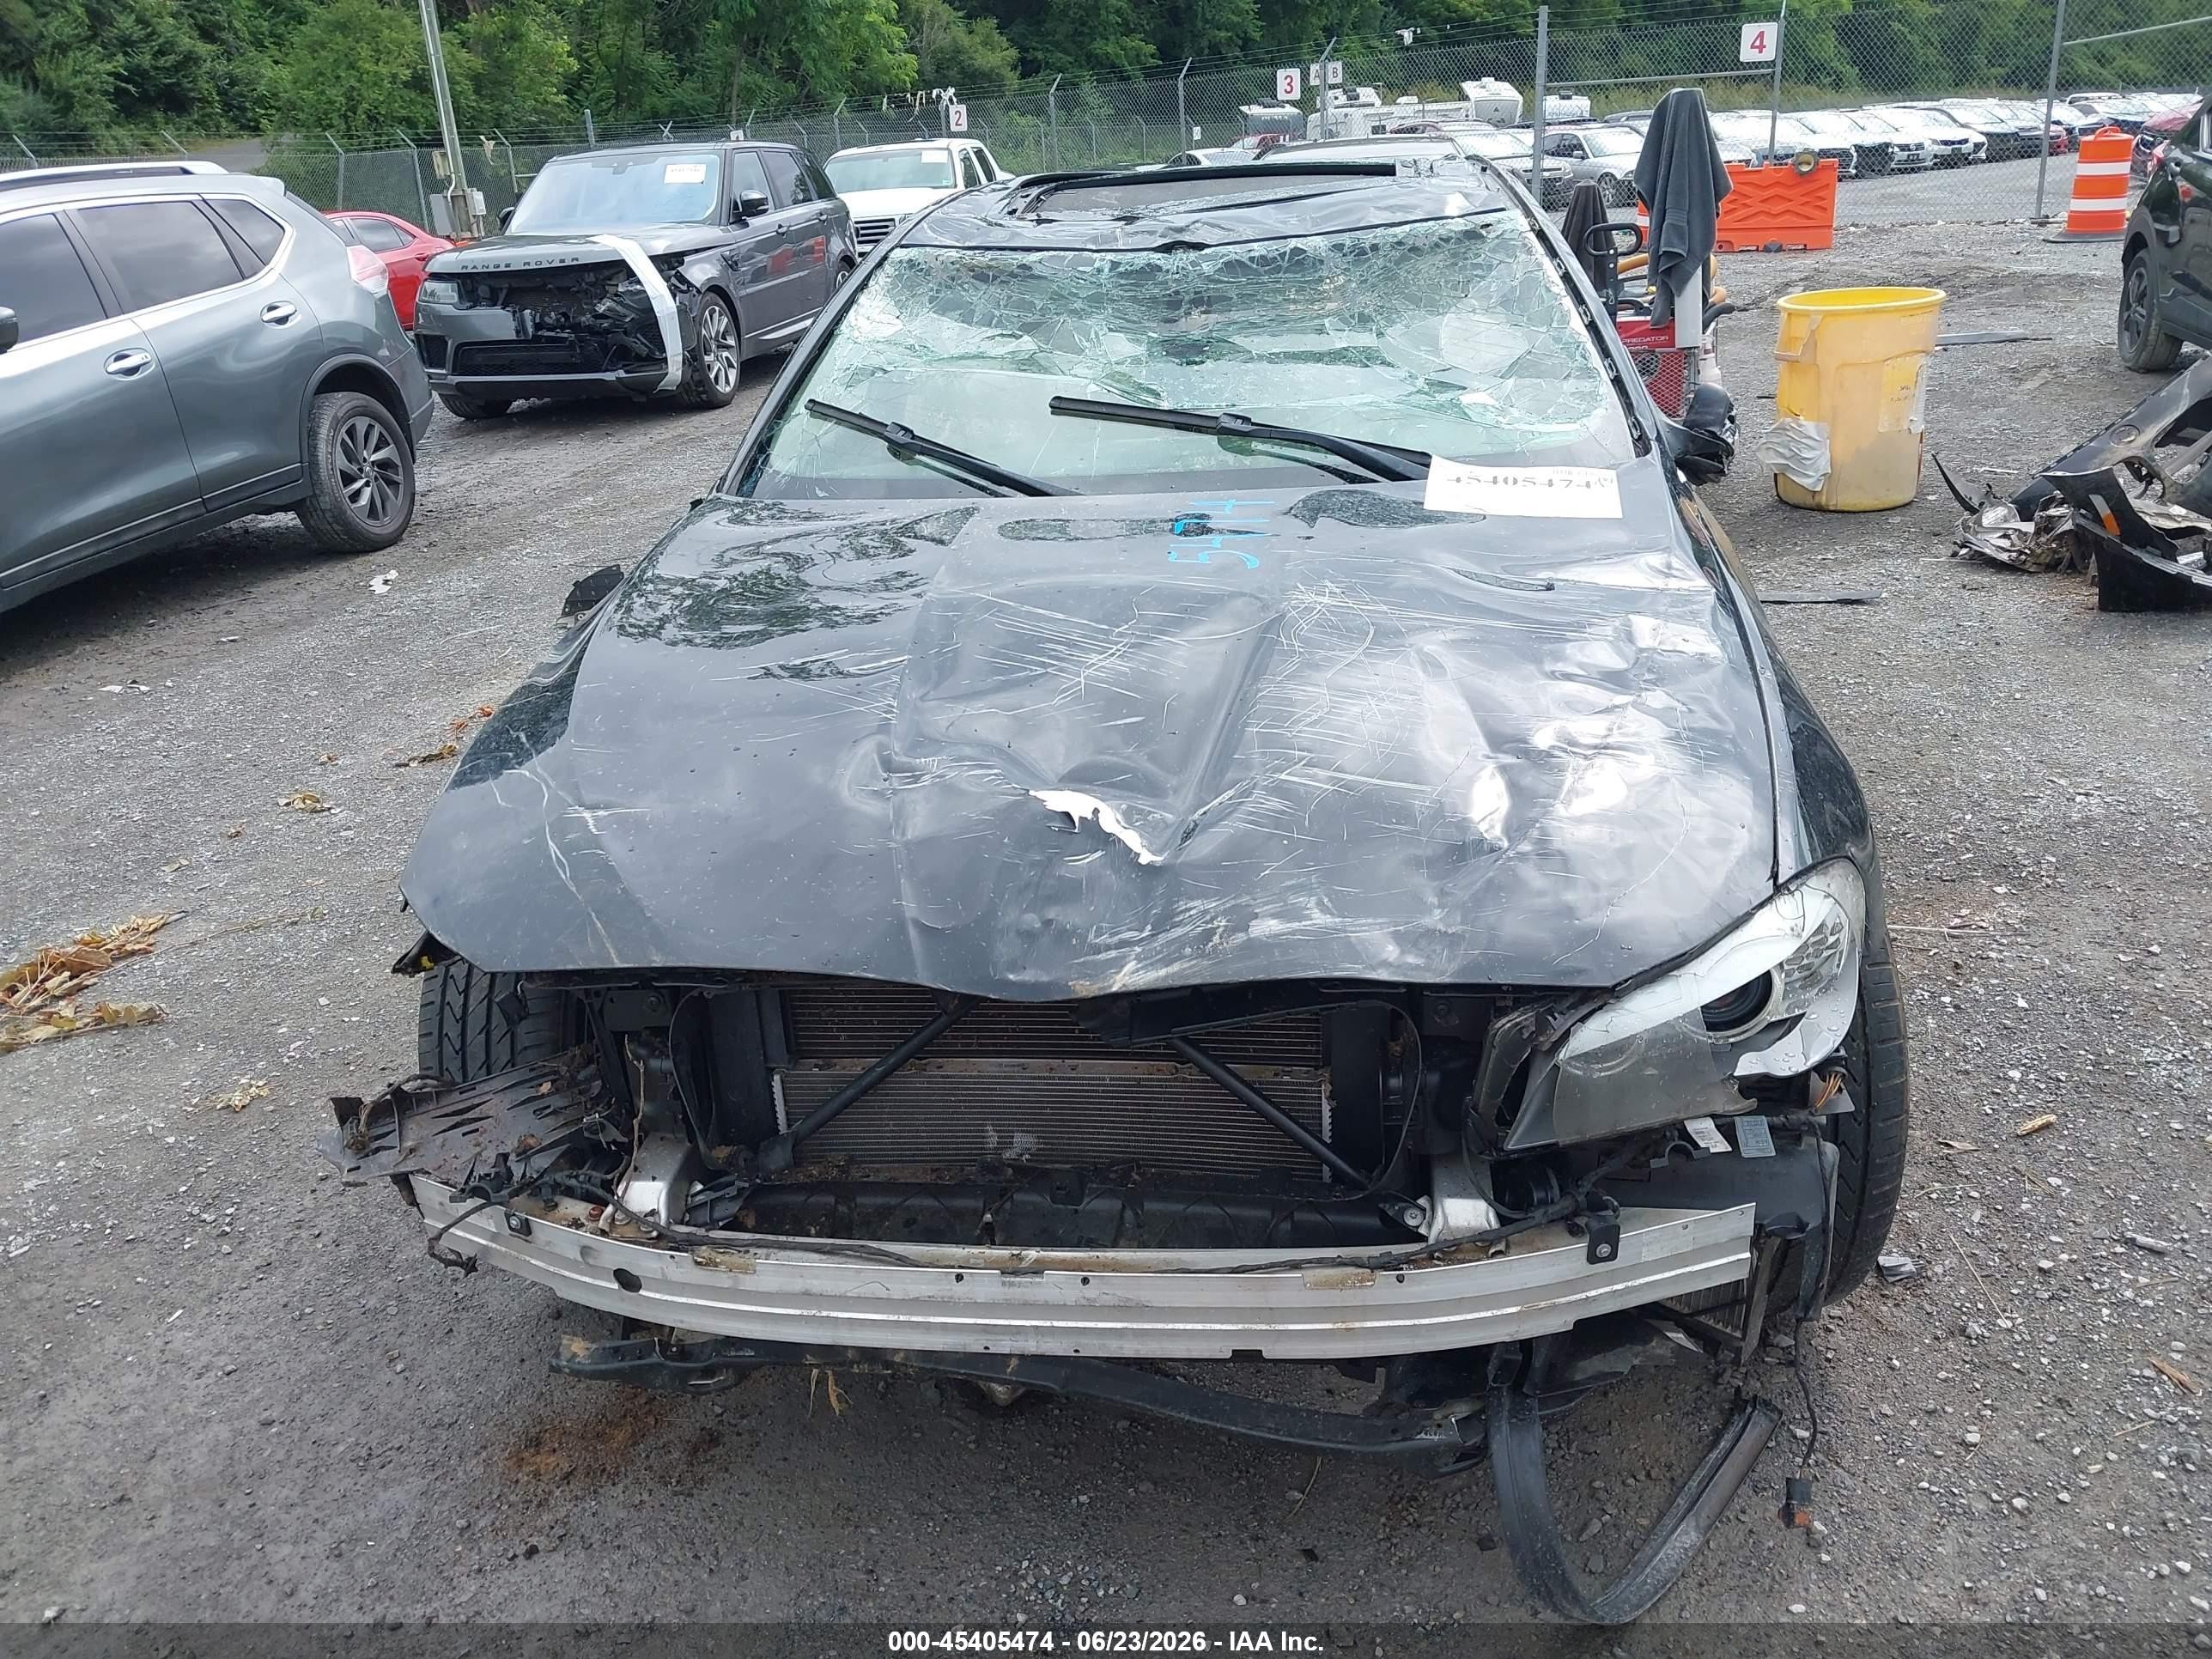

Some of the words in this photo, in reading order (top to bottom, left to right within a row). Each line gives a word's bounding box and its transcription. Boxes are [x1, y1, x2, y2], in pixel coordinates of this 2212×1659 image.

[1750, 30, 1766, 54] 4
[1332, 67, 1339, 78] B
[1284, 75, 1293, 94] 3
[954, 110, 963, 126] 2
[523, 257, 580, 267] ROVER
[1621, 335, 1669, 343] PREDATOR
